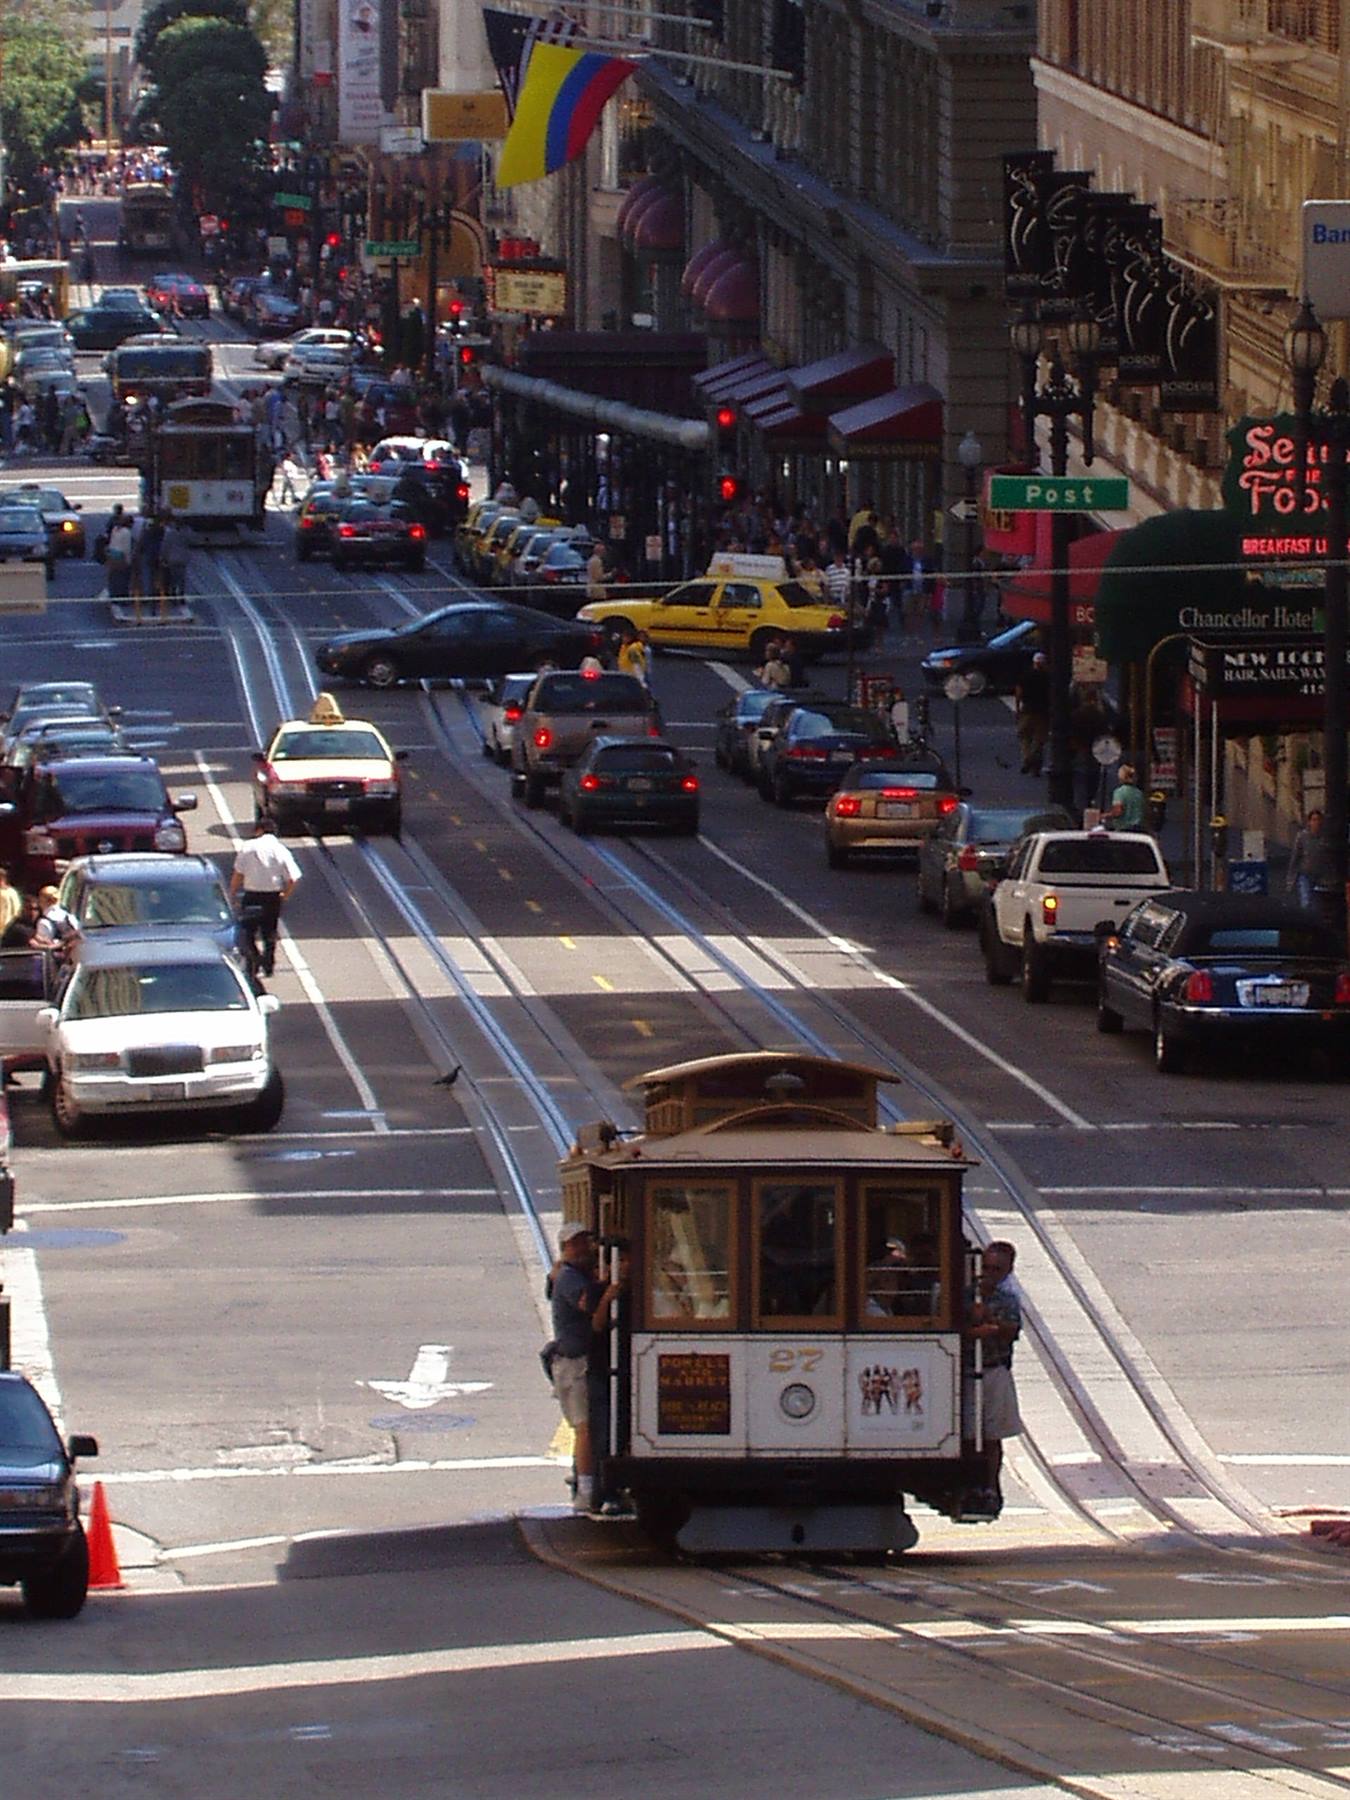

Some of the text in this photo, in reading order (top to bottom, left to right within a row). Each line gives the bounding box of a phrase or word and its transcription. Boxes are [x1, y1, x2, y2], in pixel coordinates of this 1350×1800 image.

[1026, 485, 1093, 503] Post
[1243, 538, 1311, 554] BREAKFAST
[1179, 606, 1317, 628] Chancellor Hotel
[1224, 652, 1268, 665] NEW
[769, 1349, 824, 1372] 27
